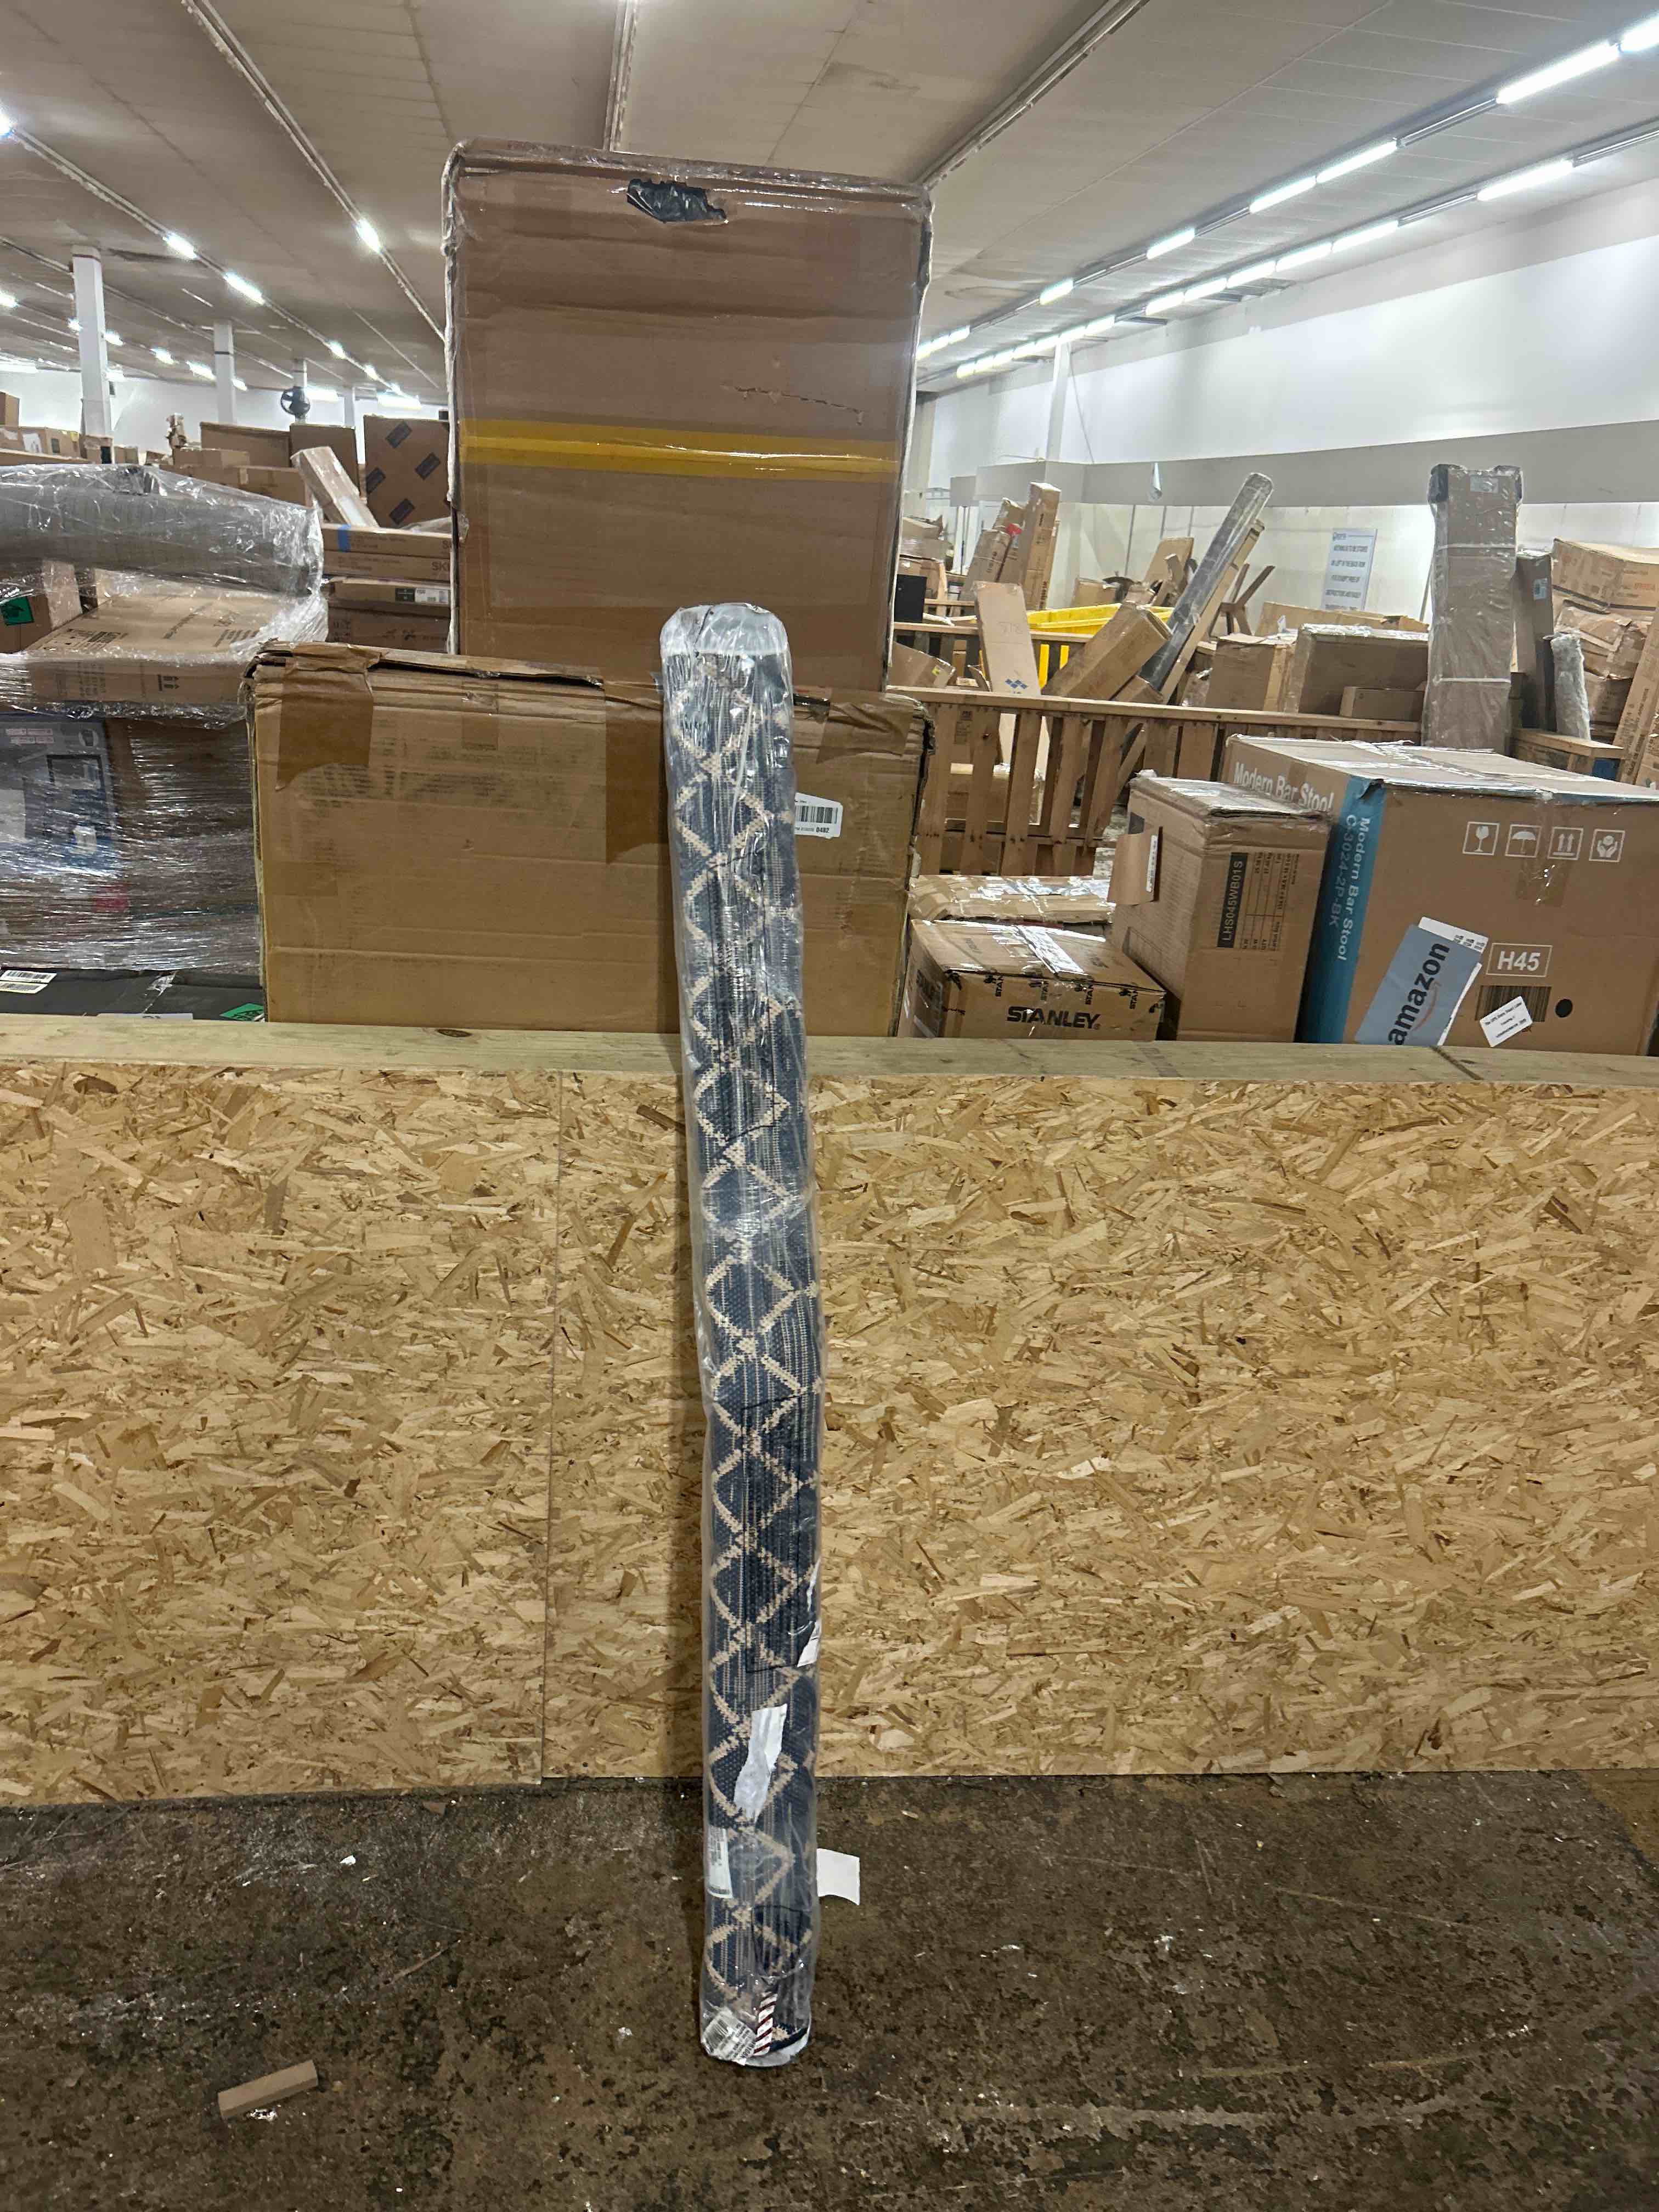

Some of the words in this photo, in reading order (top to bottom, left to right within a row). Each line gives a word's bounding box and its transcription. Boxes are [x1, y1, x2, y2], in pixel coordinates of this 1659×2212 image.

[1234, 762, 1273, 794] Modern
[1276, 775, 1298, 801] Bar
[1300, 783, 1334, 813] Stool
[1329, 815, 1357, 927] C-3024-2P-BK
[1351, 817, 1370, 879] Modern
[1346, 885, 1359, 915] Bar
[1338, 918, 1353, 960] Stool
[1497, 951, 1541, 972] H45
[1007, 1006, 1101, 1029] STANLEY
[1388, 944, 1450, 1046] amazon
